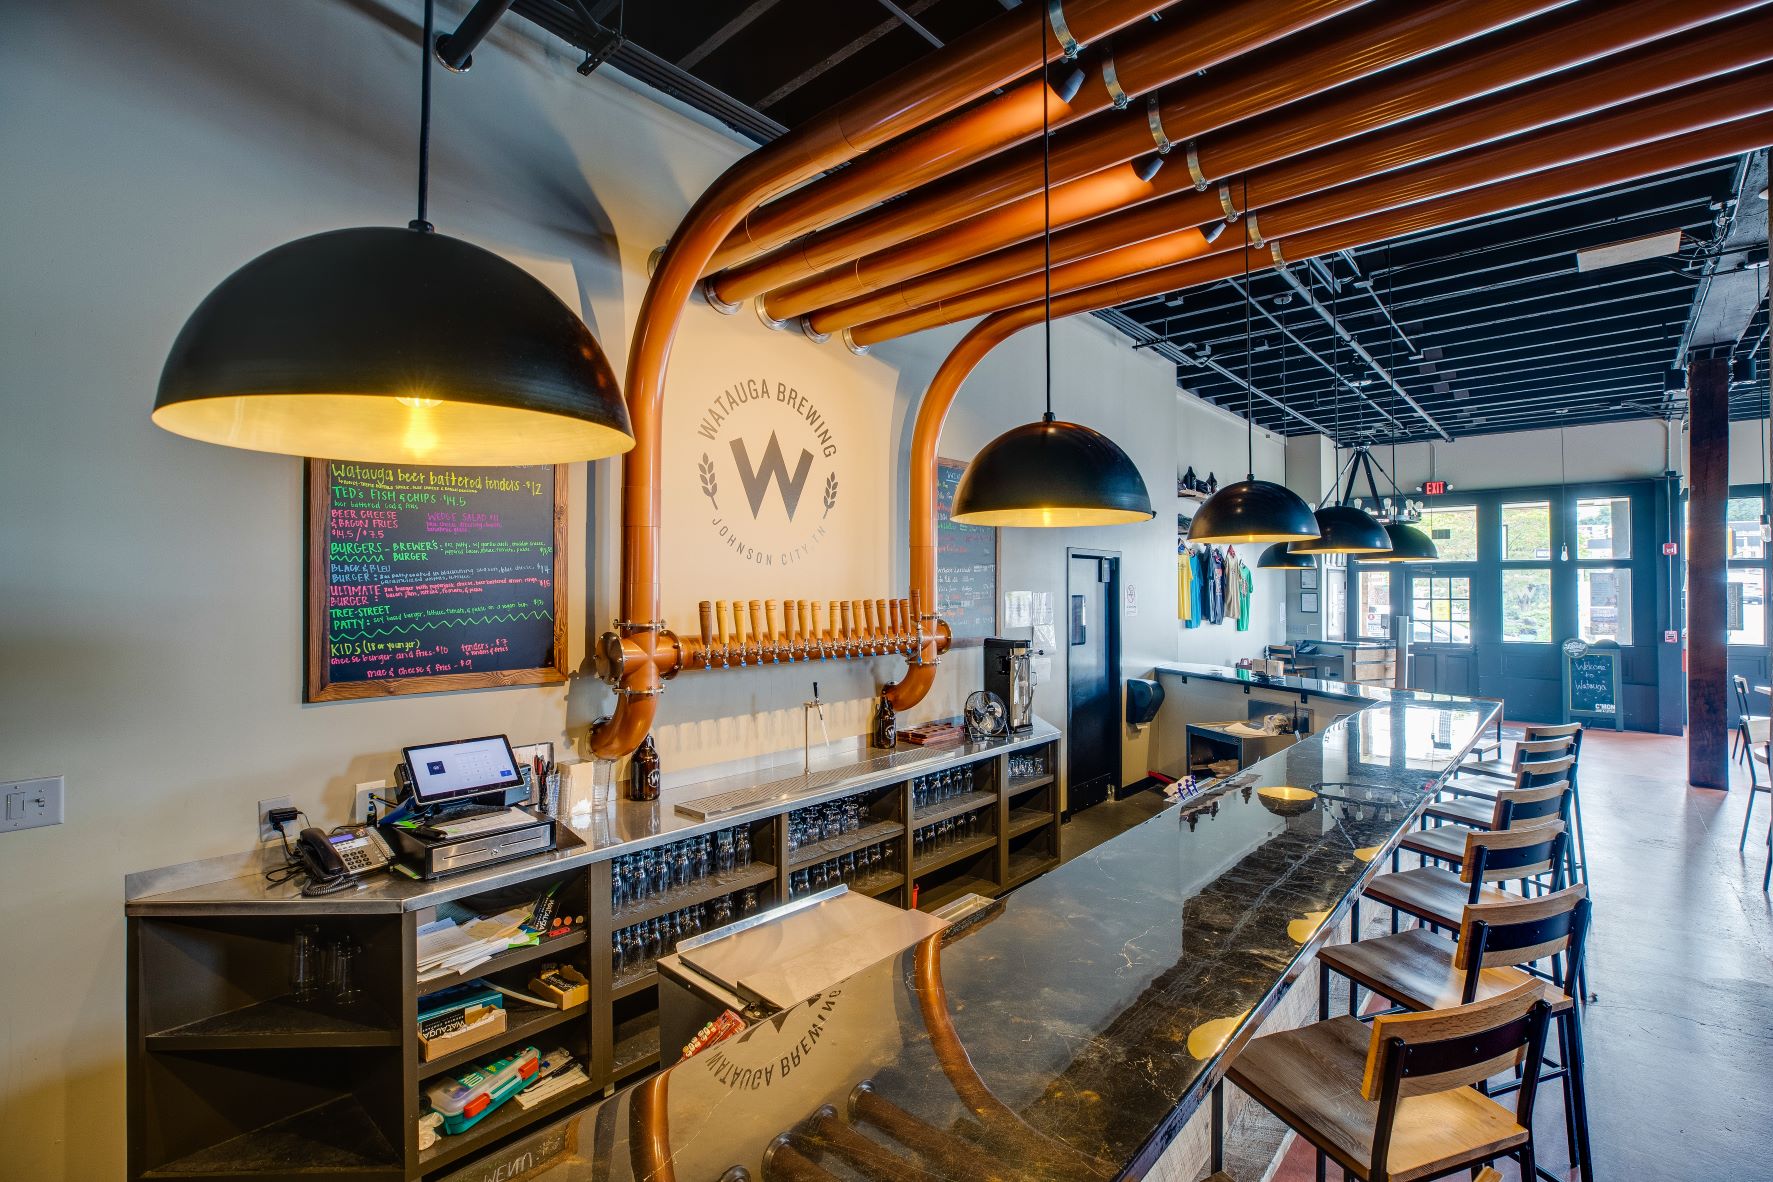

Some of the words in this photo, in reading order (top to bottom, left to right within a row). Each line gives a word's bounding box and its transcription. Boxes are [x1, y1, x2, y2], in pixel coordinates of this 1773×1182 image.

[698, 378, 771, 441] WATAUGA
[776, 382, 837, 458] BREWING
[331, 463, 394, 484] Watauga
[397, 469, 426, 483] beer
[429, 471, 482, 490] battered
[485, 476, 520, 491] tenders
[729, 428, 815, 523] W
[1426, 482, 1445, 495] EXIT
[370, 489, 396, 502] FISH
[406, 493, 437, 503] CHIPS
[331, 509, 358, 519] BEER
[360, 510, 397, 520] CHEESE
[339, 519, 369, 528] BACON
[373, 519, 399, 529] FRIES
[711, 517, 772, 566] JOHNSON
[331, 543, 383, 555] BURGERS
[393, 552, 429, 561] BURGER
[331, 564, 360, 573] BLACK
[330, 585, 382, 595] ULTIMATE
[331, 643, 361, 657] KIDS
